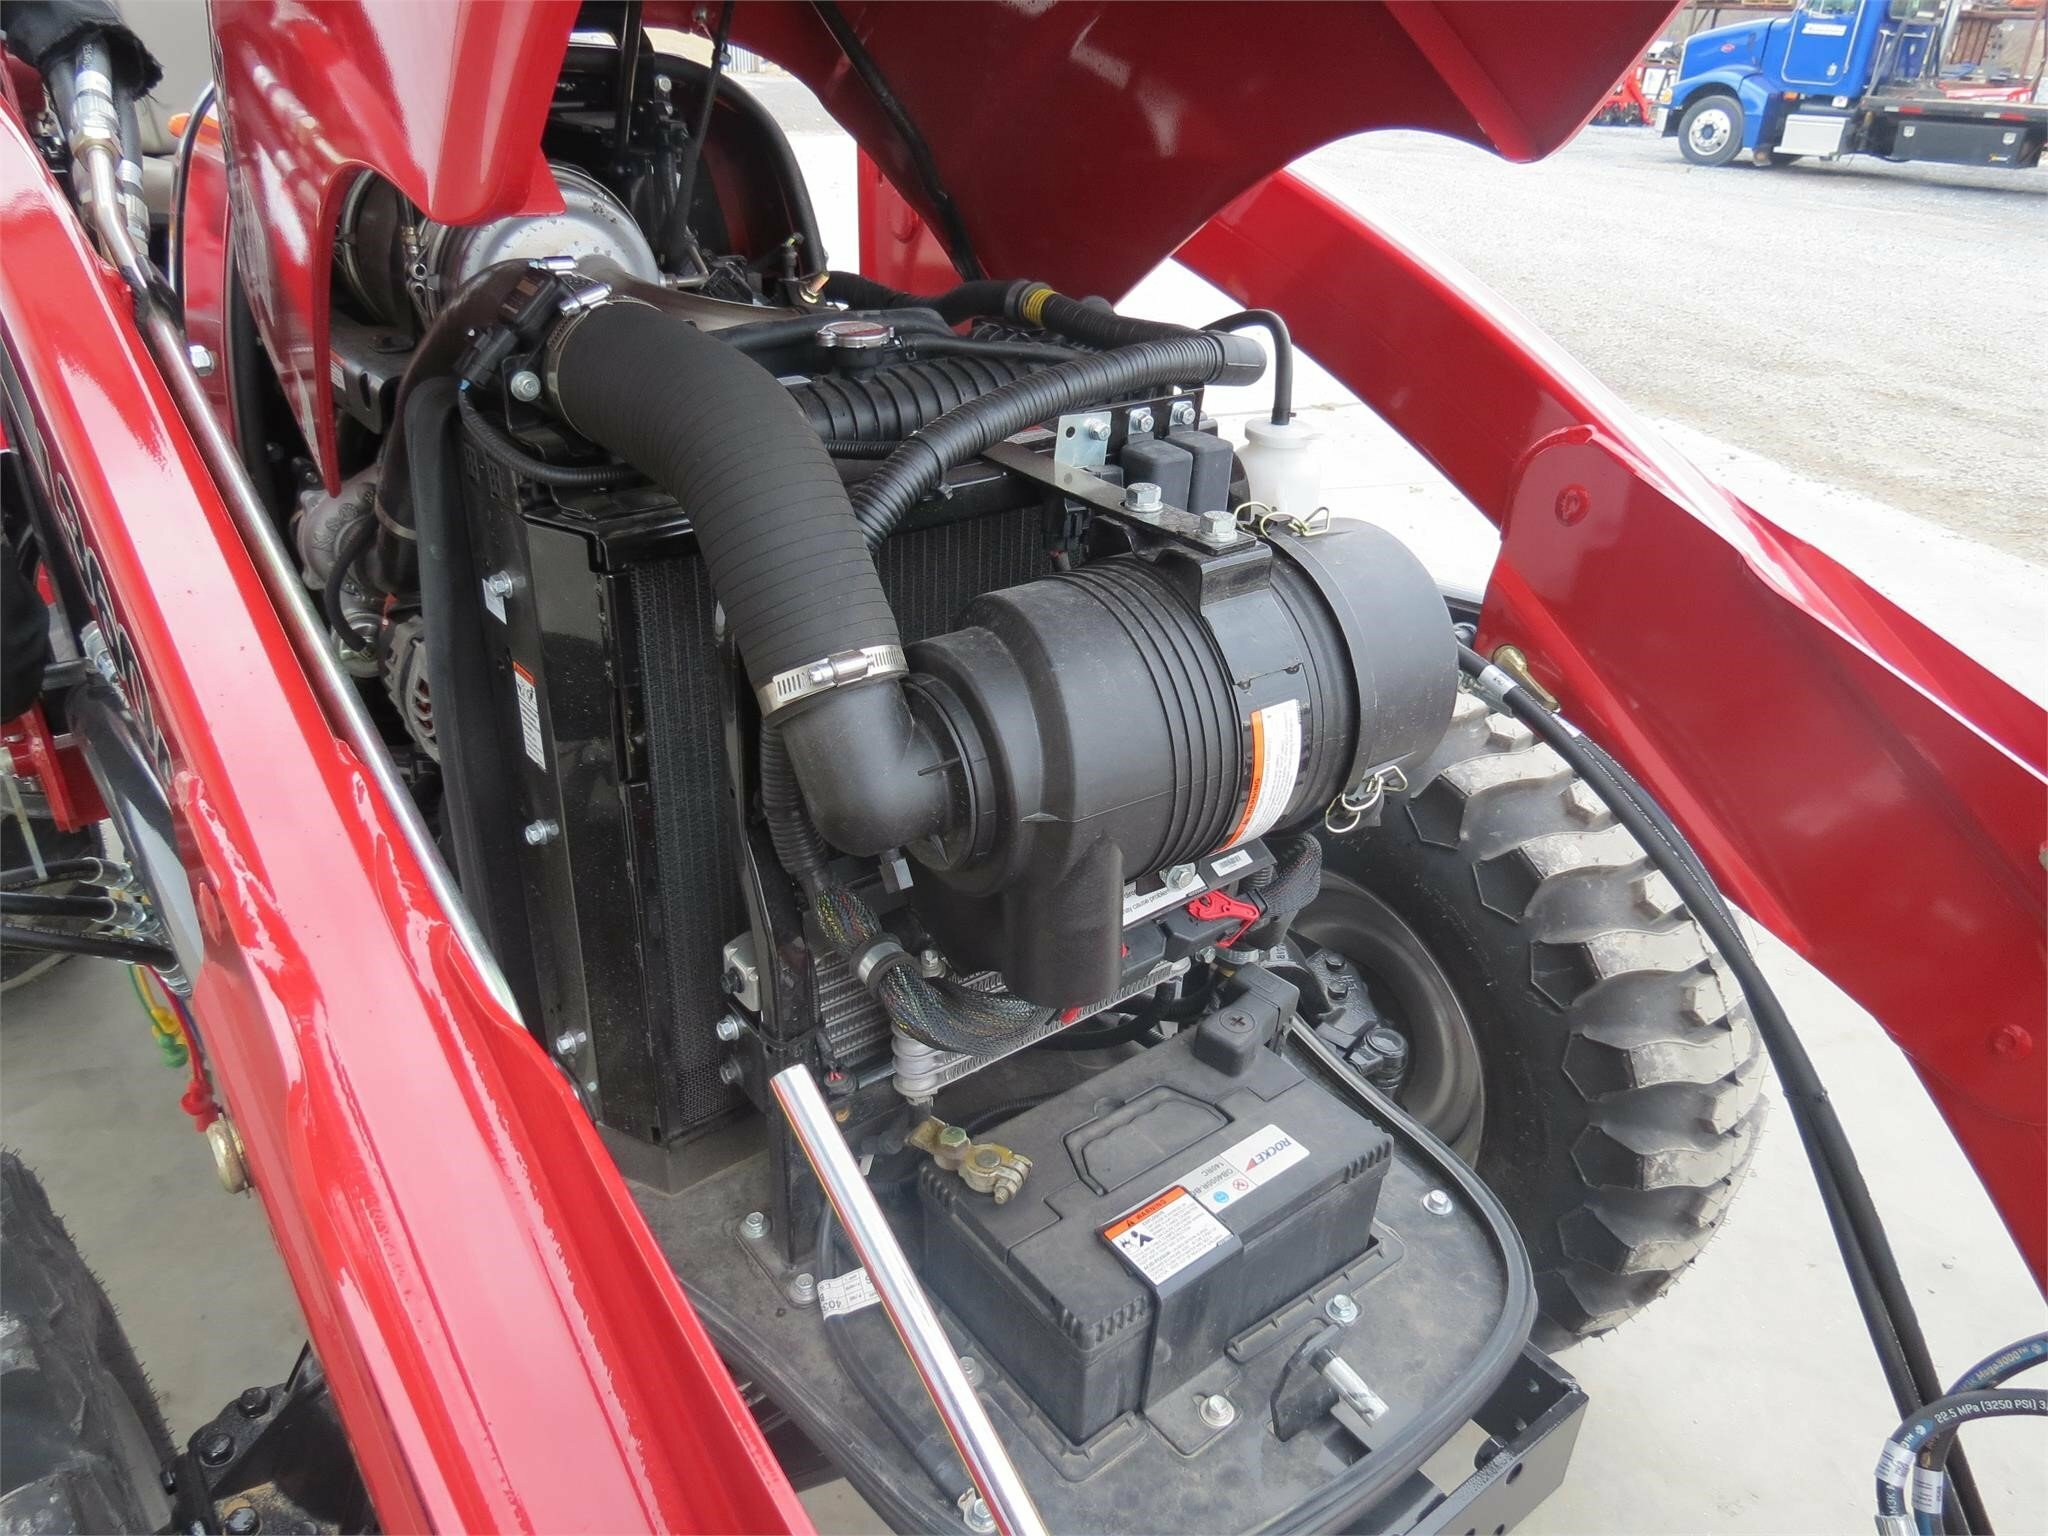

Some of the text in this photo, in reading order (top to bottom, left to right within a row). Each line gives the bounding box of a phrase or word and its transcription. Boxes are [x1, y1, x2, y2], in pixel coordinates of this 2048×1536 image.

[1135, 1199, 1167, 1220] WARNING
[1934, 1408, 1957, 1424] 22.5
[1957, 1403, 1979, 1416] MPa
[1980, 1399, 2012, 1412] (3250
[2014, 1398, 2036, 1410] PSI)
